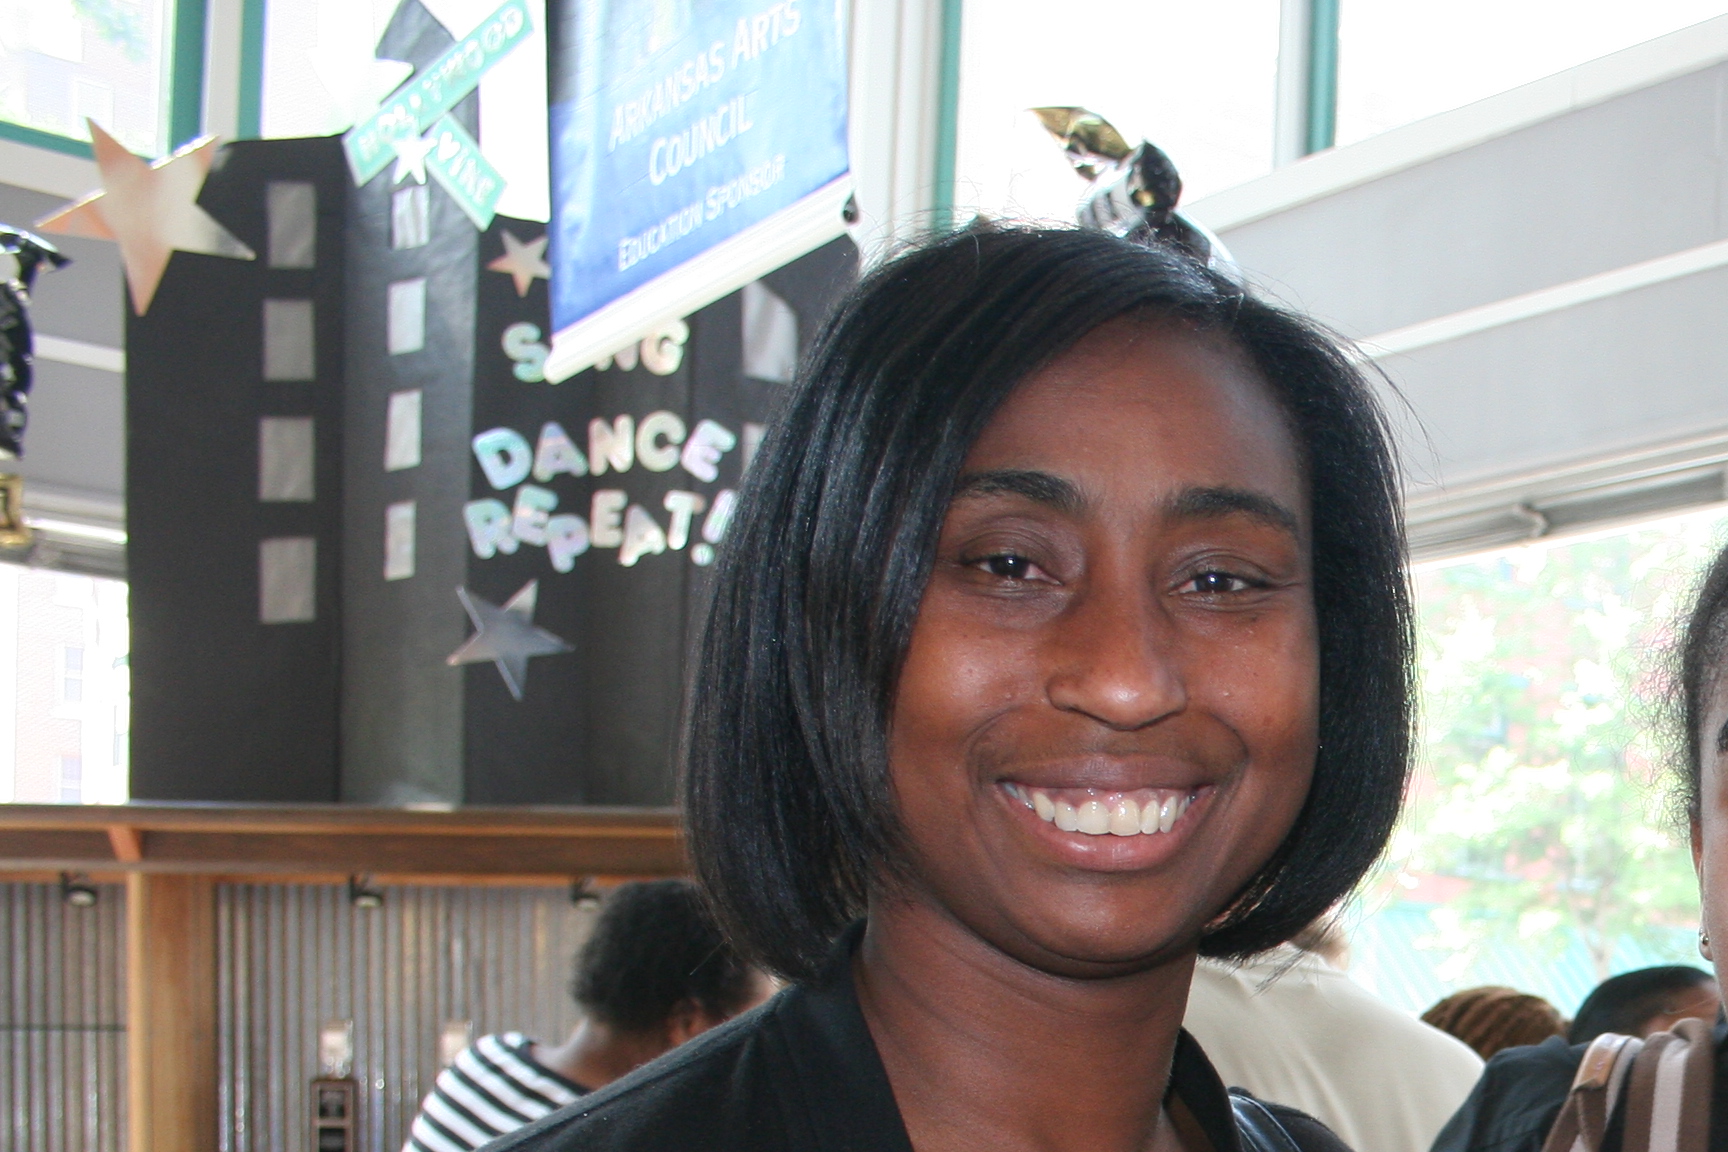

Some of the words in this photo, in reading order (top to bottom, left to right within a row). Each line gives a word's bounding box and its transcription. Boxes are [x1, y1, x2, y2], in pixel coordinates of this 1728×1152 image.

[607, 41, 726, 152] ARKANSAS
[731, 0, 801, 69] ARTS
[650, 95, 753, 186] COUNCIL
[617, 200, 704, 272] EDUCATION
[706, 153, 786, 221] SPONSOR
[501, 319, 690, 382] SG
[472, 410, 737, 490] DANCE
[462, 484, 739, 573] REPEAT!
